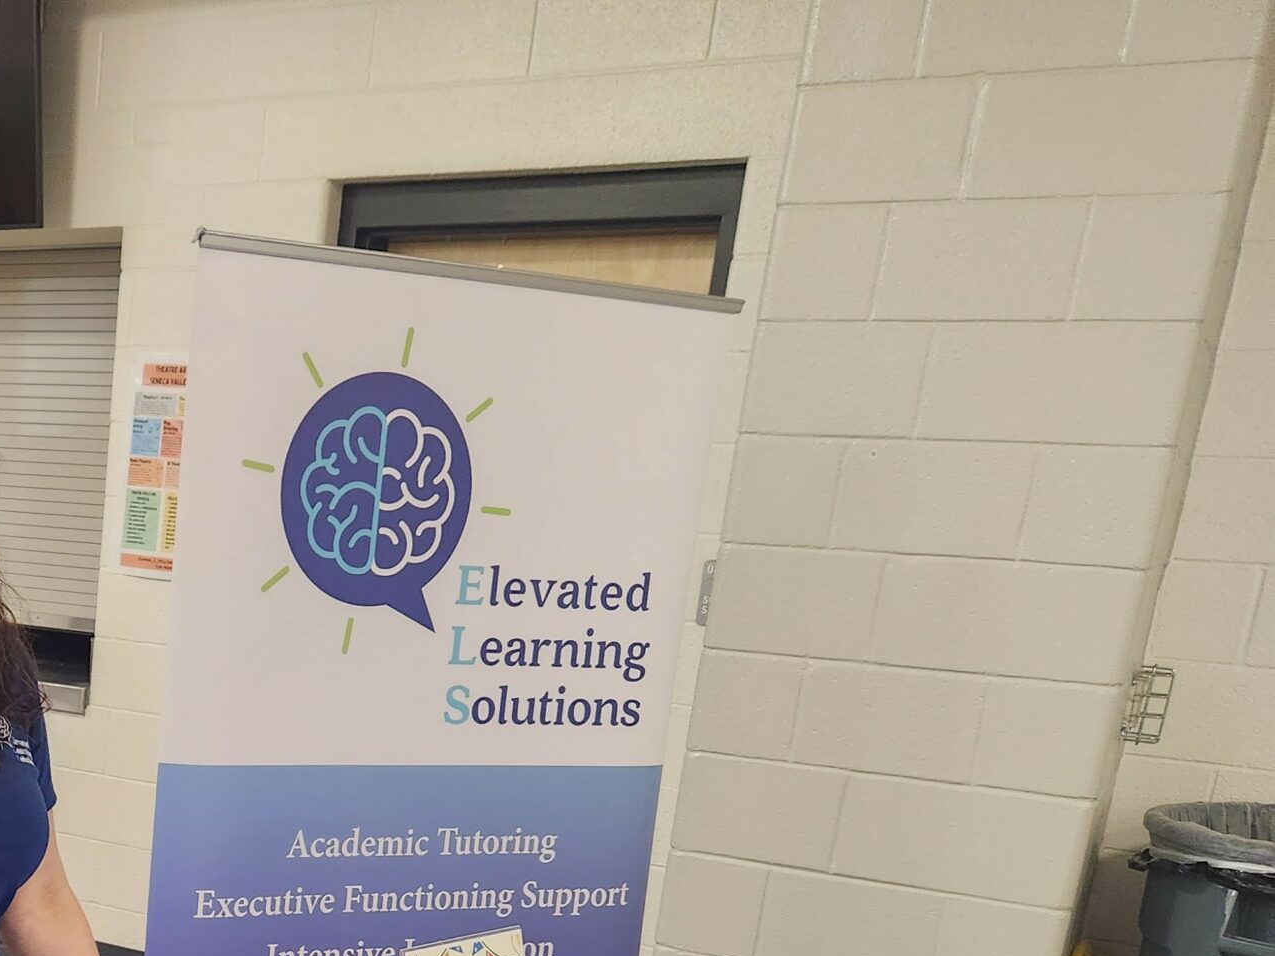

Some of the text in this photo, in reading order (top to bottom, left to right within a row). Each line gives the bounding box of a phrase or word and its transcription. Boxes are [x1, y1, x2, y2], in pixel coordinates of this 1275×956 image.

[170, 378, 187, 386] VALLE
[455, 564, 651, 612] Elevated
[448, 625, 650, 683] Learning
[444, 685, 641, 728] Solutions
[286, 827, 558, 863] Academic Tutoring
[193, 880, 629, 920] Executive Functioning Support
